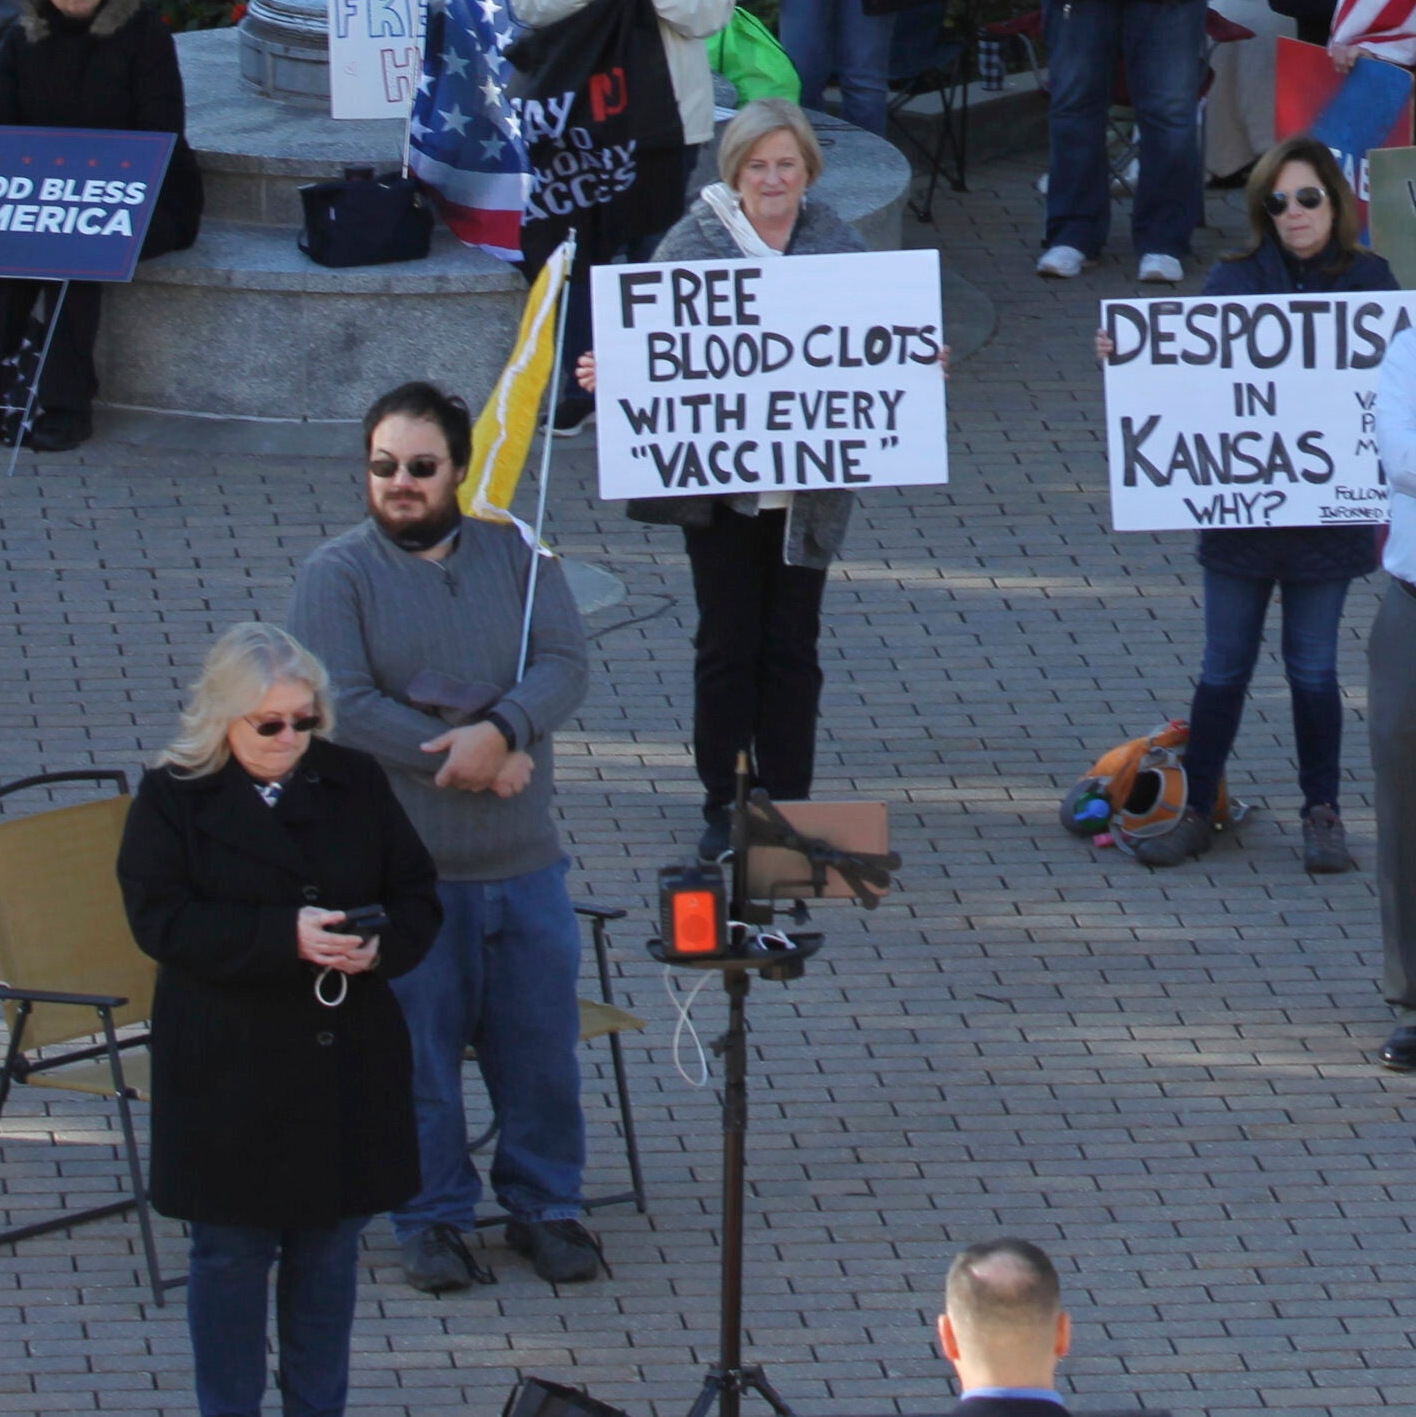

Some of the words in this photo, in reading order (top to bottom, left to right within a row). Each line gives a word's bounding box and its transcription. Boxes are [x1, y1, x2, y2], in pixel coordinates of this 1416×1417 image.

[39, 177, 147, 205] BLESS
[619, 267, 762, 329] FREE
[647, 331, 795, 383] BLOOD
[803, 324, 940, 368] CLOTS
[618, 392, 747, 435] WITH
[765, 389, 906, 432] EVERY
[1232, 381, 1277, 417] IN
[1119, 414, 1335, 487] KANSAS
[1182, 489, 1288, 527] WHY?
